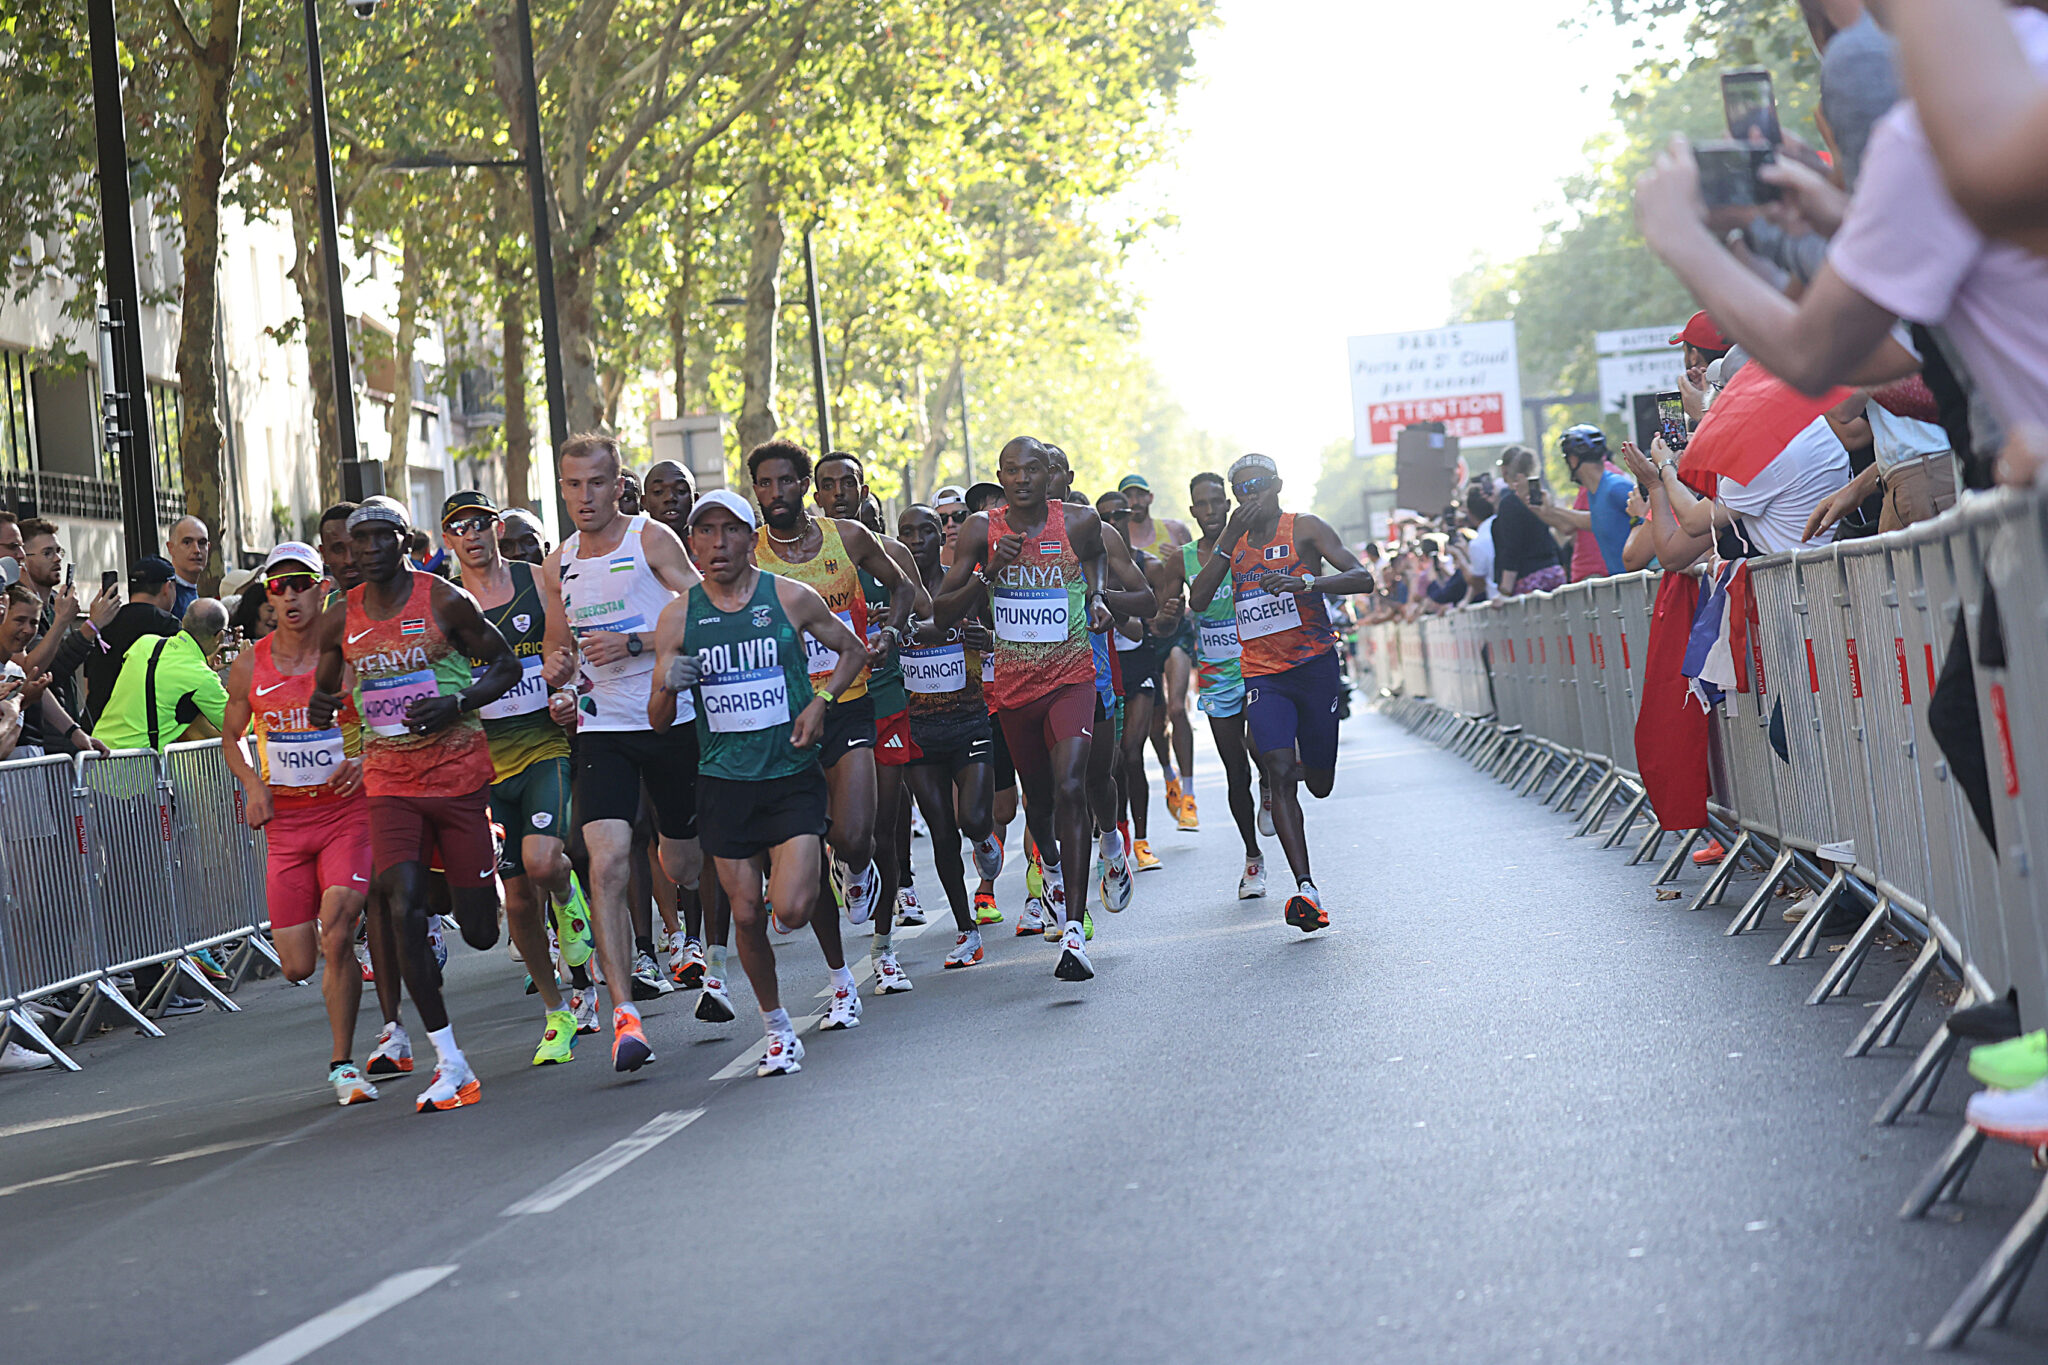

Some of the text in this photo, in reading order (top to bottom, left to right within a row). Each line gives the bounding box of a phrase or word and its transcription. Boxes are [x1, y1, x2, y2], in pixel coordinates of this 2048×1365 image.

[1398, 331, 1463, 350] PARIS
[1355, 359, 1400, 374] Porte
[1407, 356, 1426, 371] de
[1459, 347, 1509, 367] Cloud
[1380, 371, 1487, 397] par tunnel
[1372, 396, 1500, 424] ATTENTION
[997, 565, 1064, 587] KENYA
[996, 605, 1067, 625] MUNYAO
[1236, 597, 1297, 626] NAGEEYE
[1202, 632, 1238, 647] HASS
[354, 646, 429, 673] KENYA
[699, 637, 778, 676] BOLIVIA
[900, 660, 964, 679] KIPLANGAT
[718, 672, 762, 682] PARIS 2024
[1848, 656, 1858, 697] ALTRAD
[705, 686, 784, 714] GARIBAY
[278, 749, 333, 768] YANG
